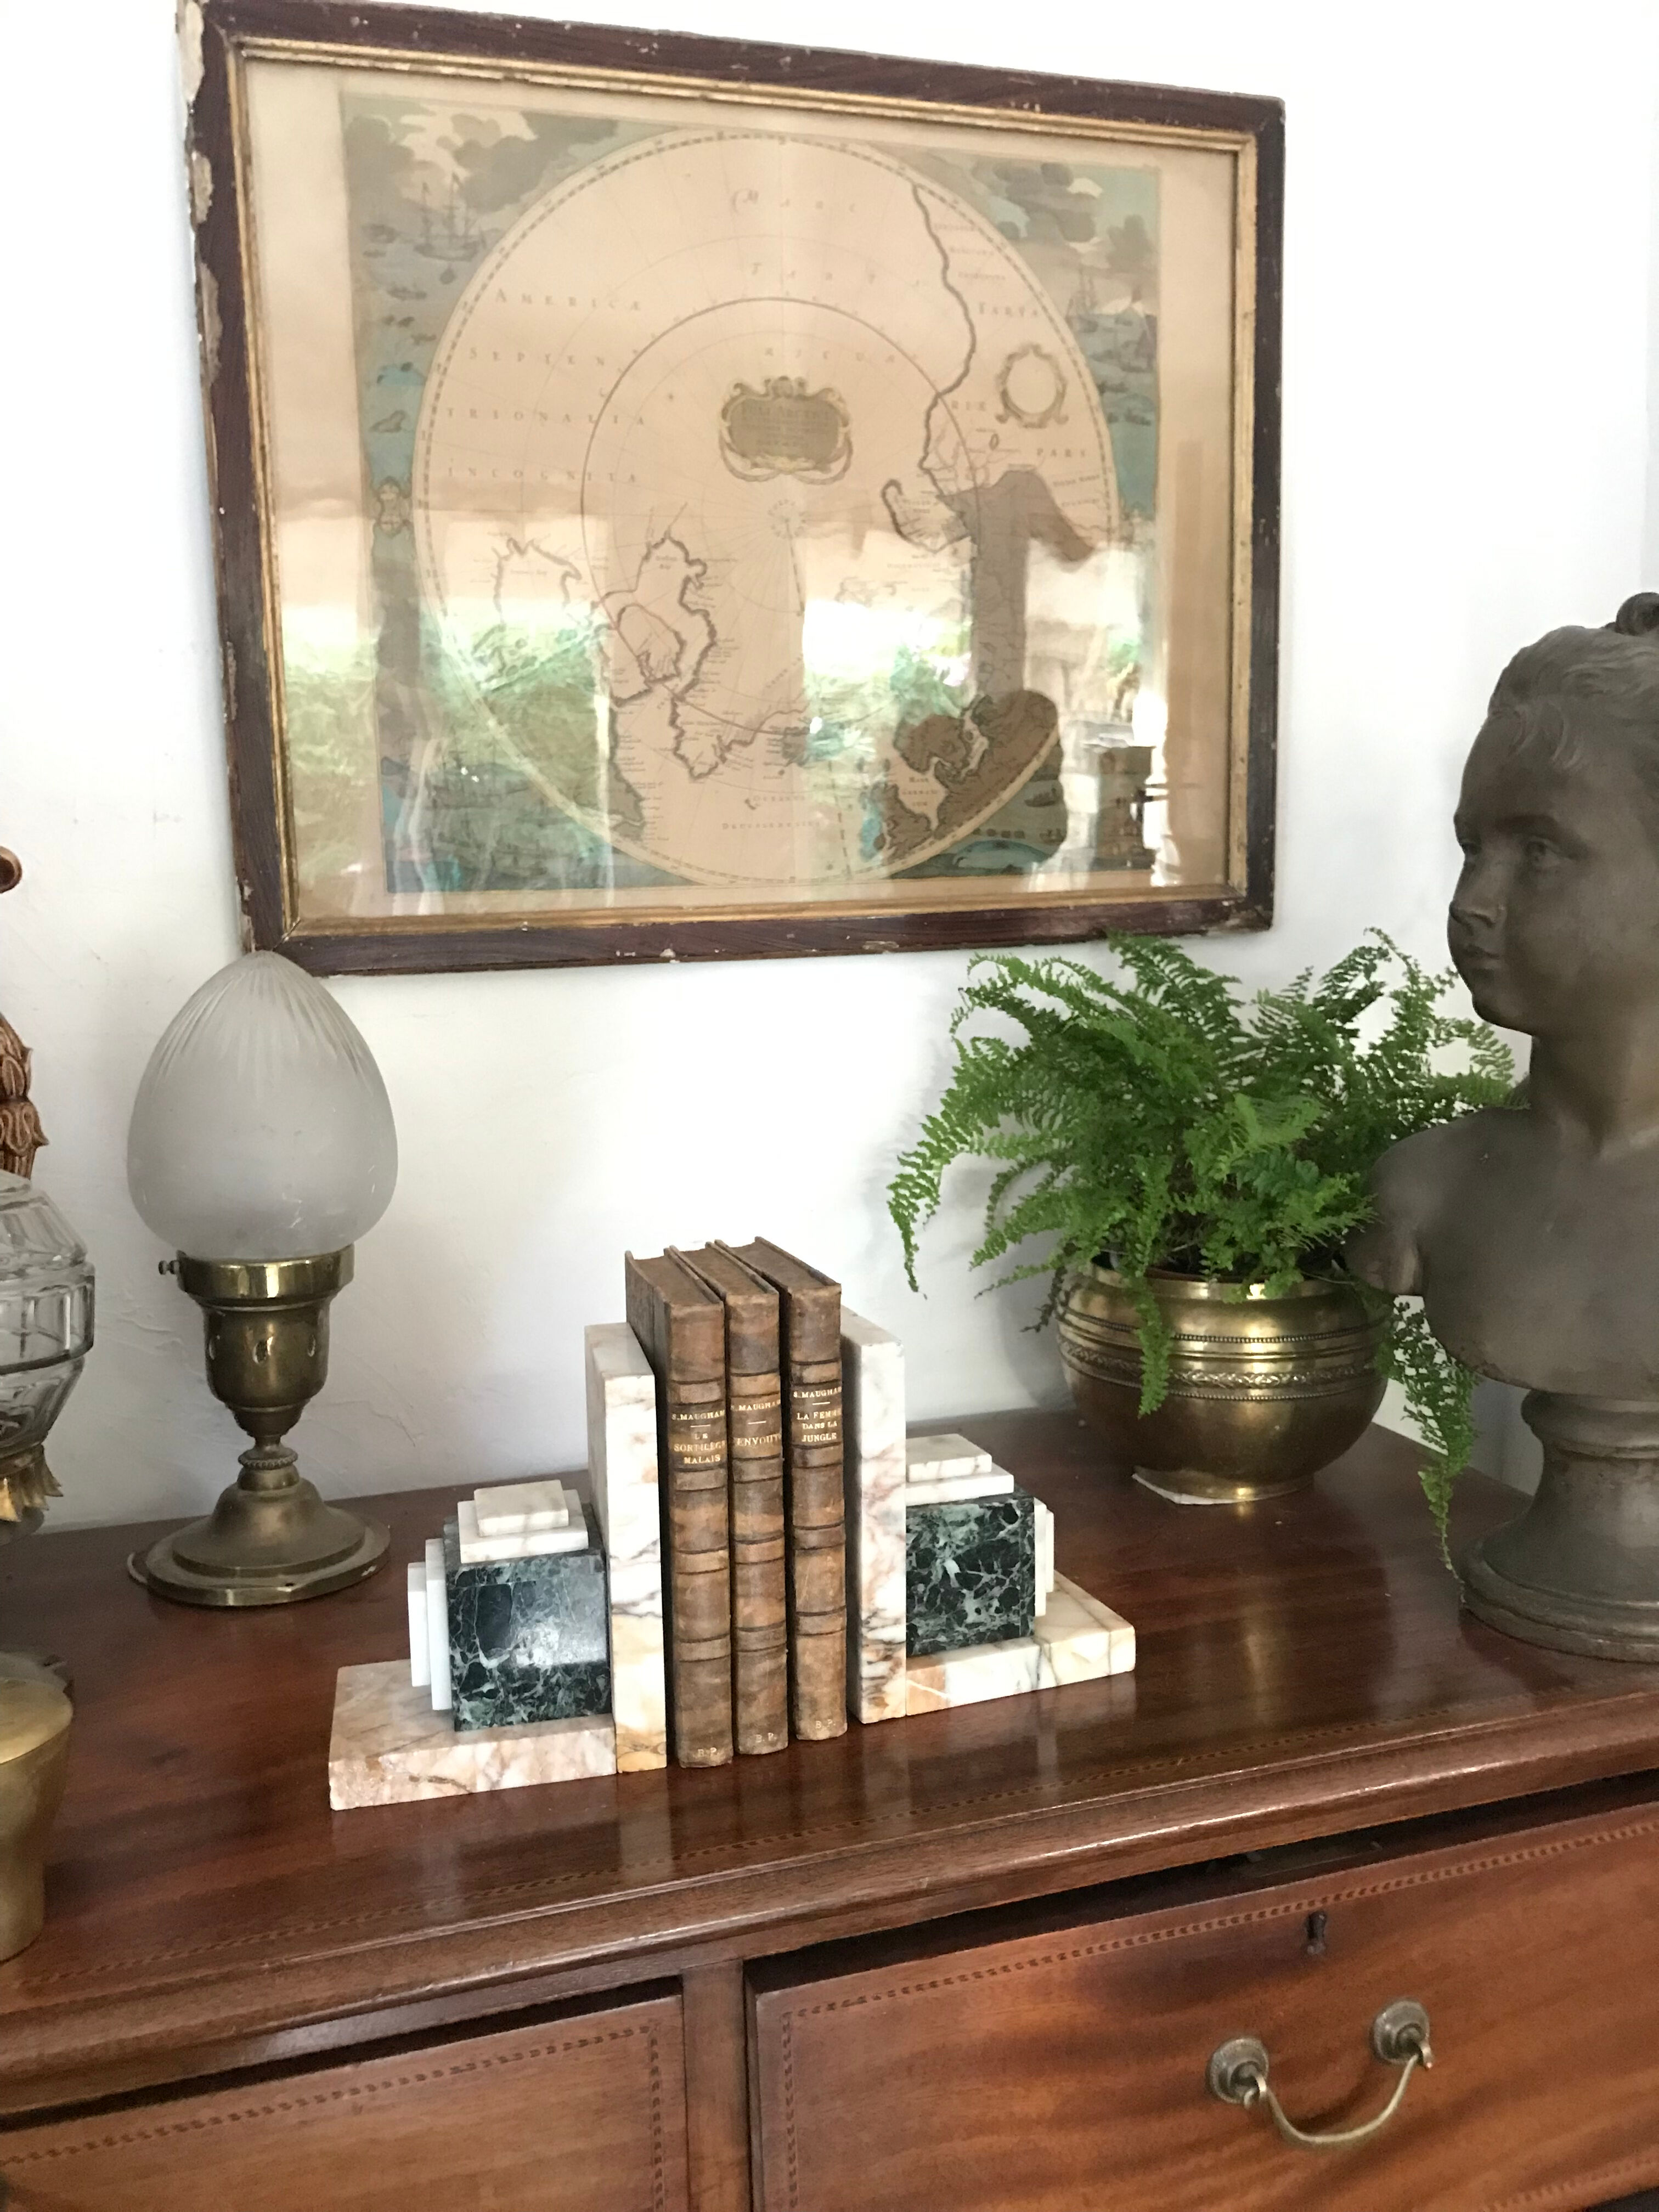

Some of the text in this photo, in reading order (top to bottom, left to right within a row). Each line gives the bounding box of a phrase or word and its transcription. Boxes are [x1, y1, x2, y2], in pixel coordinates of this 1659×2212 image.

[797, 1412, 809, 1420] LA
[802, 1432, 837, 1442] JUNGLE
[684, 1454, 721, 1464] MALAIS
